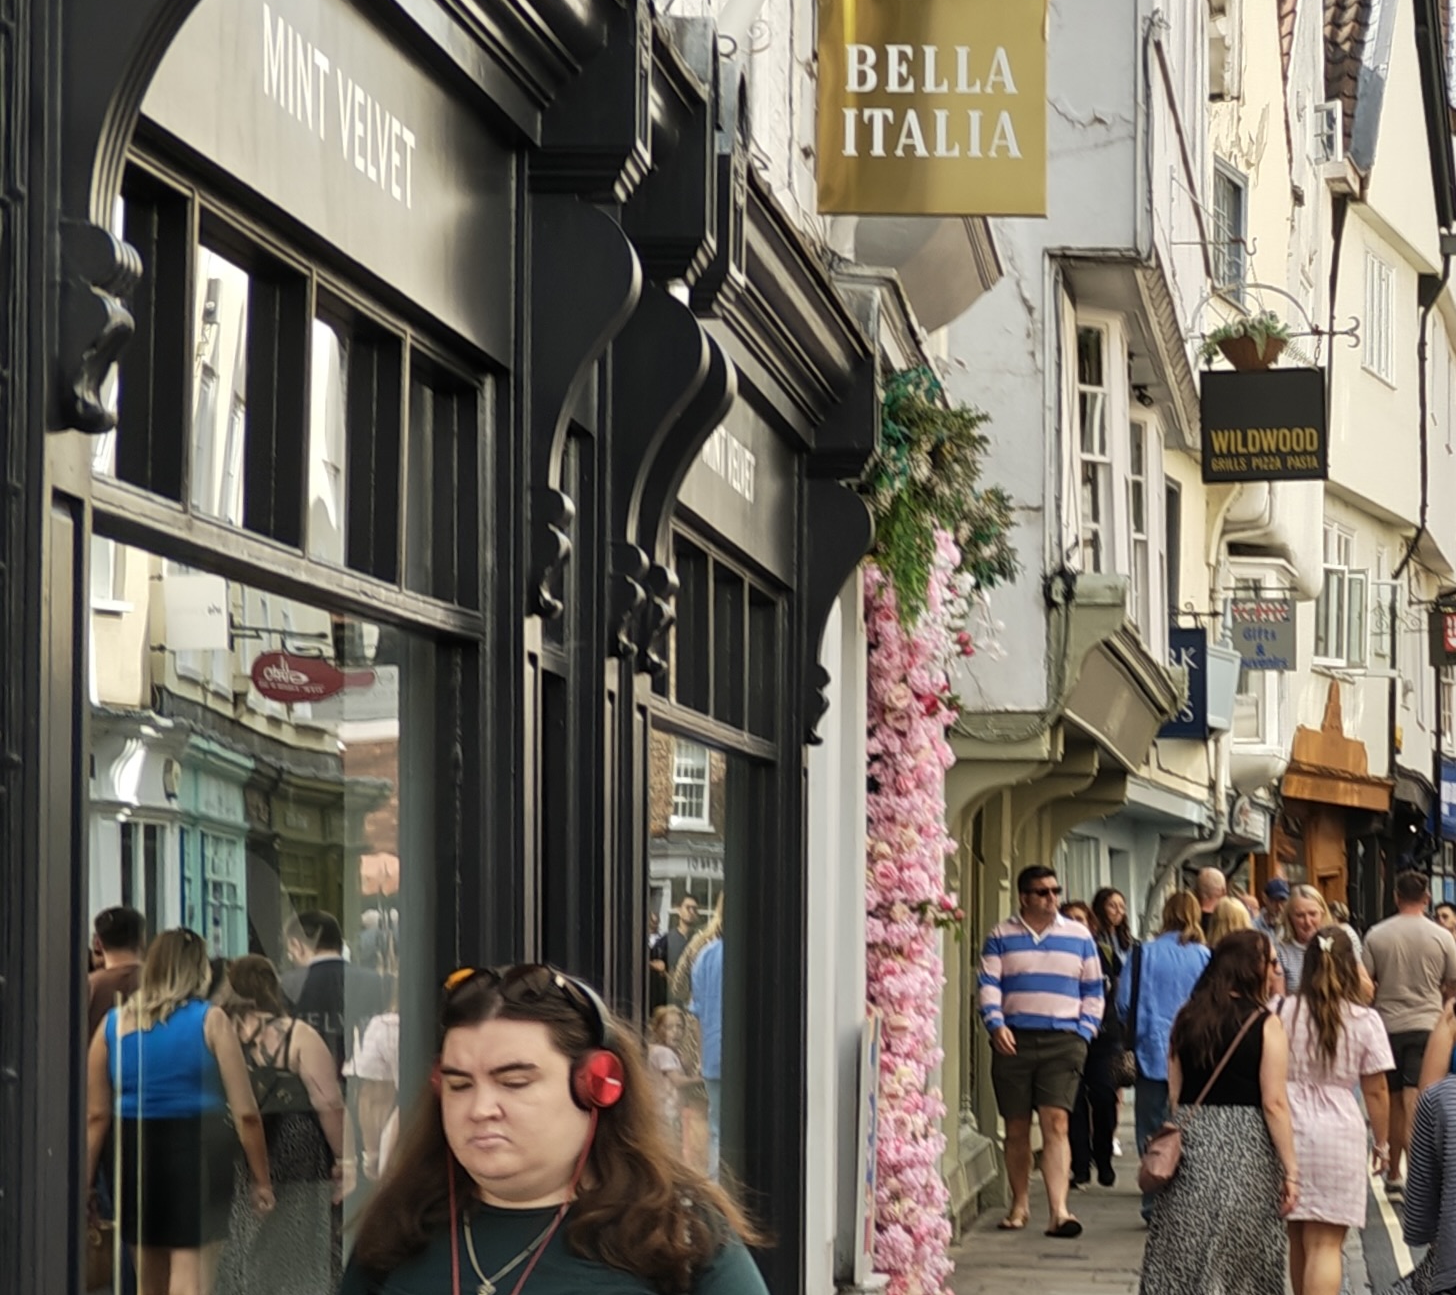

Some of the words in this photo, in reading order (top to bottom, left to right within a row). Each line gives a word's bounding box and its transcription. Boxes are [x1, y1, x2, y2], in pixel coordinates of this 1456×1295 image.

[845, 43, 1018, 94] BELLA
[263, 2, 330, 141] MINT
[336, 67, 416, 210] VELVET
[842, 107, 1023, 159] ITALIA
[1210, 427, 1319, 455] WILDWOOD
[1211, 456, 1248, 472] GRILLS
[1251, 455, 1282, 471] PIZZA
[1286, 454, 1319, 470] PASTA
